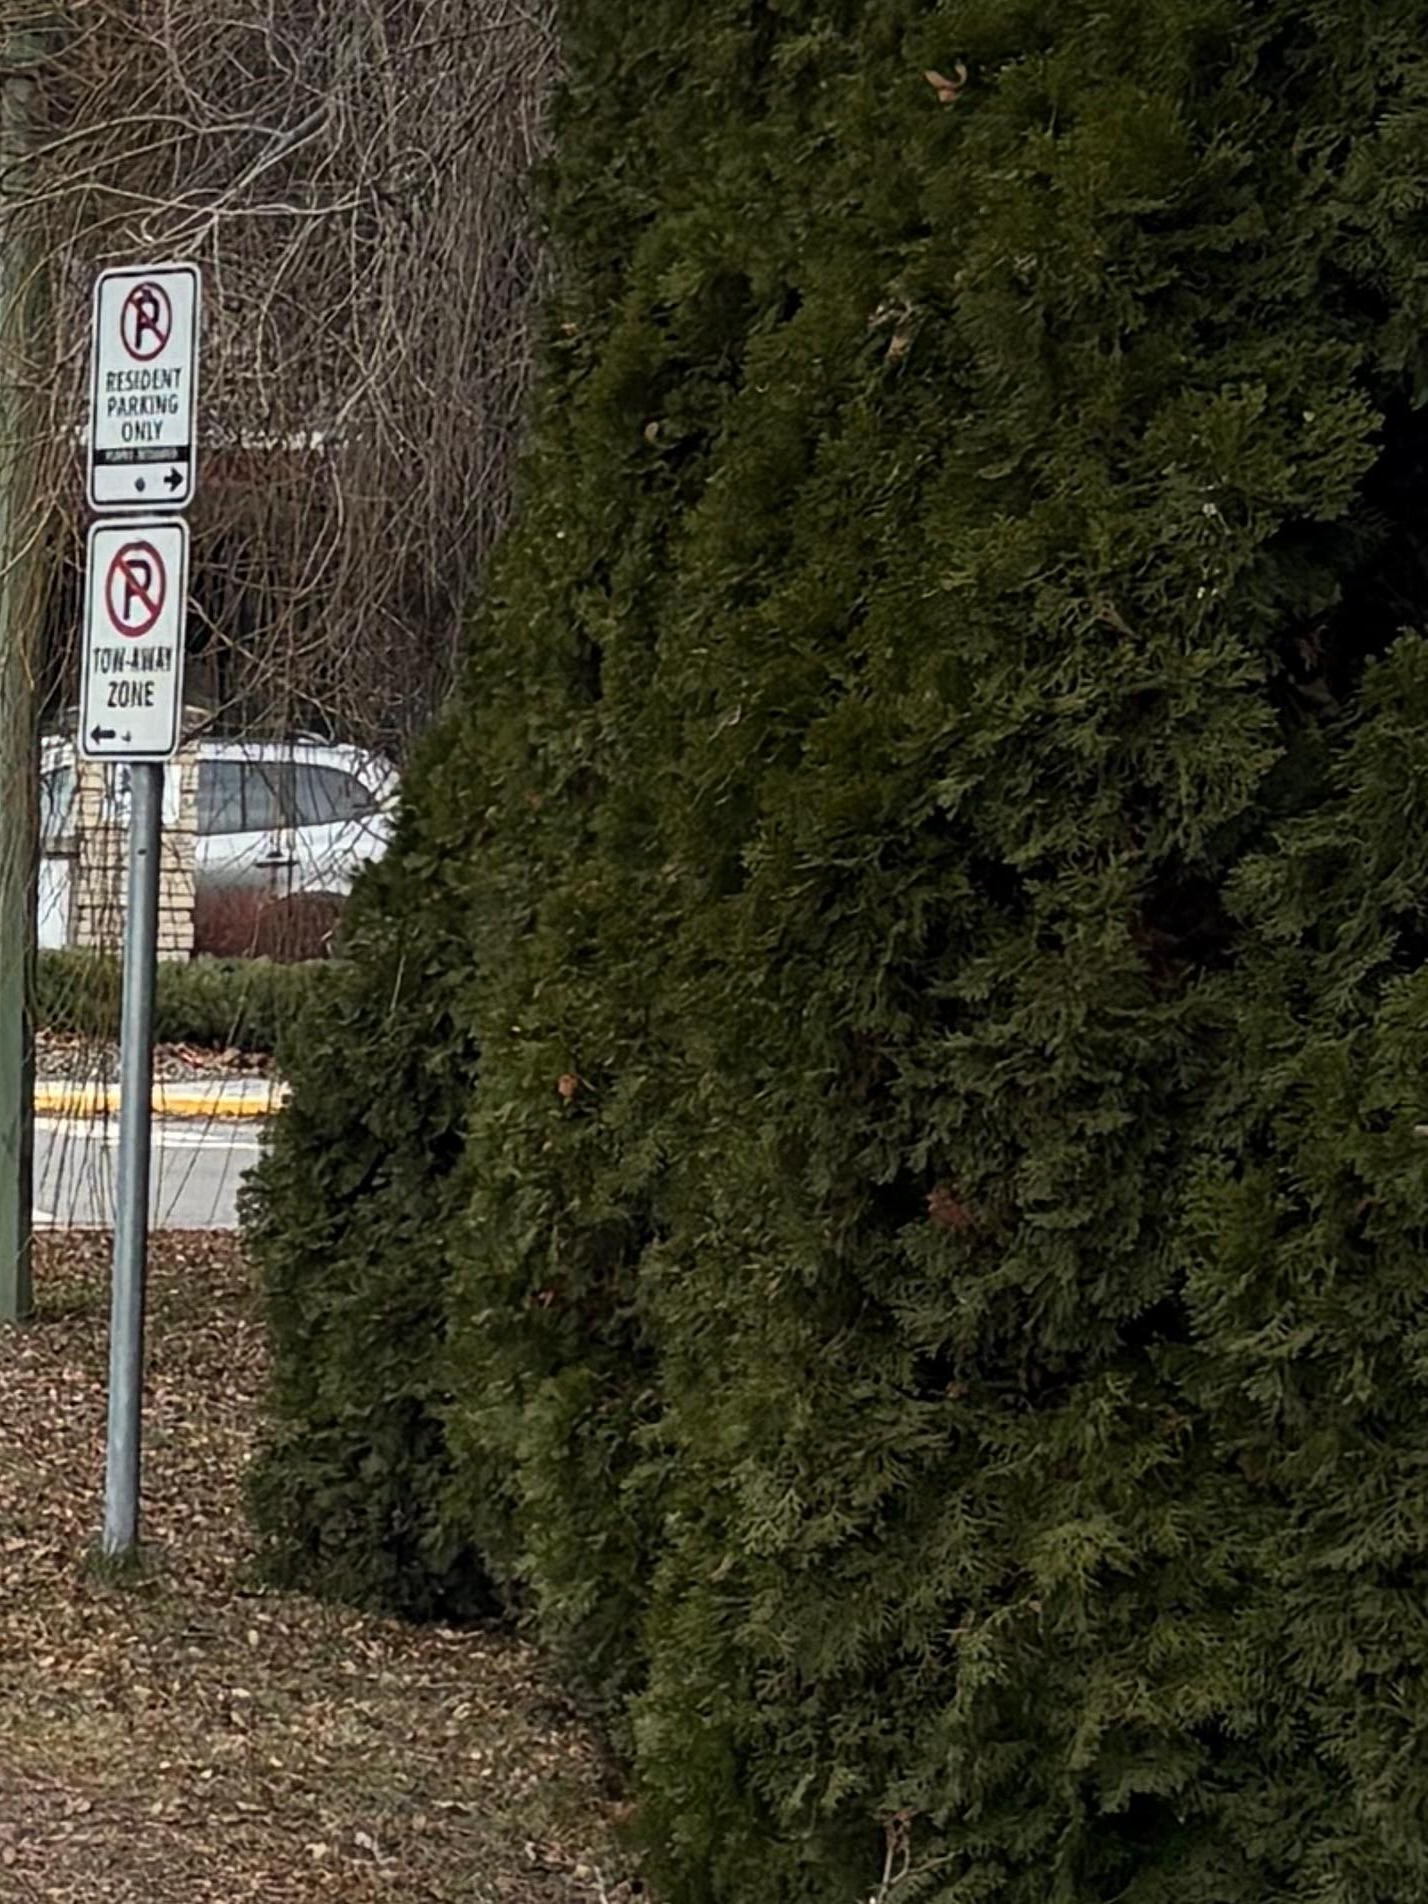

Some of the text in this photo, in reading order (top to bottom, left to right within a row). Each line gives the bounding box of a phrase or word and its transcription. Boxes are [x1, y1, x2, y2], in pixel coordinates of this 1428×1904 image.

[105, 367, 182, 392] RESIDENT
[106, 393, 179, 417] PARKING
[121, 419, 163, 443] ONLY
[93, 646, 172, 674] TOW-AWAY
[107, 680, 155, 708] ZONE
